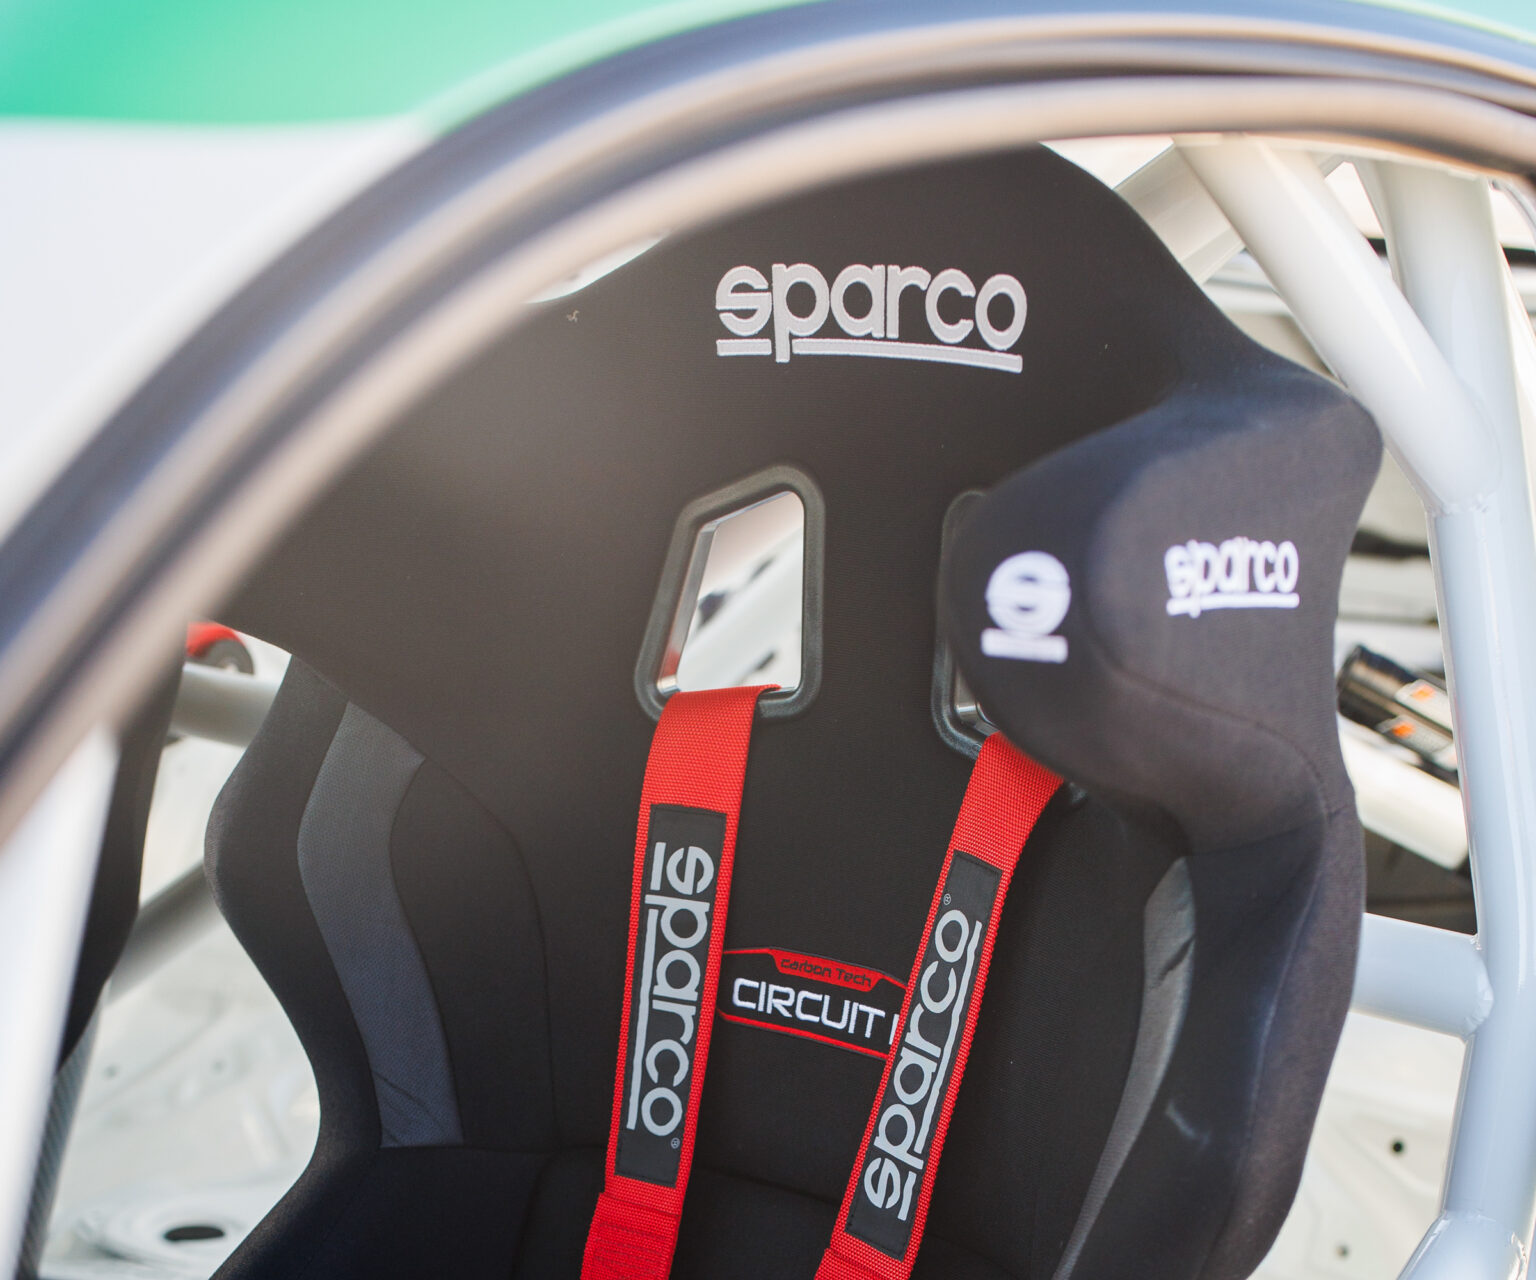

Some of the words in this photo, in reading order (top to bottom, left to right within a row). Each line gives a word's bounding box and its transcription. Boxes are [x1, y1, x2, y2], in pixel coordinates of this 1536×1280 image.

[715, 263, 1027, 363] sparco
[1164, 537, 1299, 618] sparco
[641, 845, 714, 1136] sparco
[732, 978, 886, 1039] CIRCUIT
[864, 909, 969, 1209] sparco
